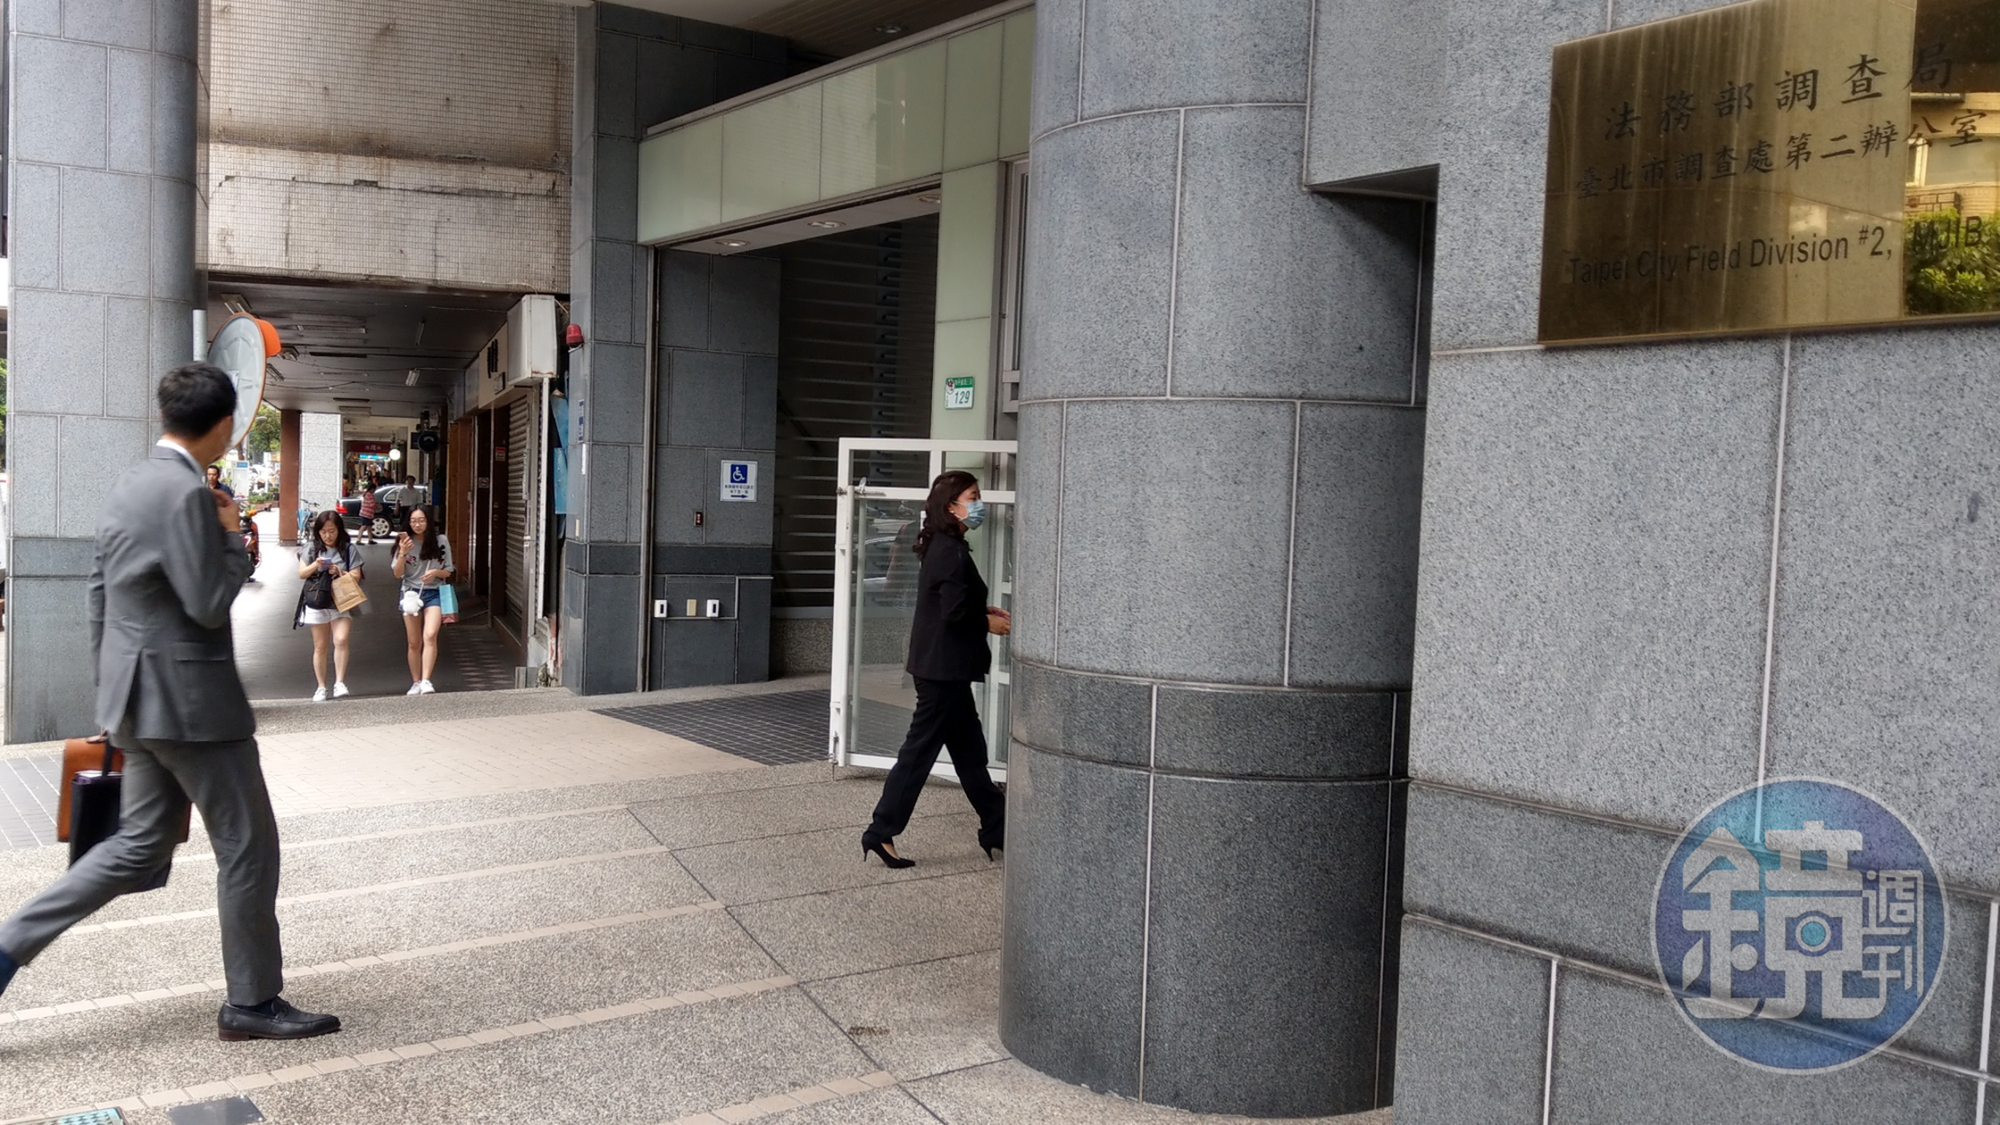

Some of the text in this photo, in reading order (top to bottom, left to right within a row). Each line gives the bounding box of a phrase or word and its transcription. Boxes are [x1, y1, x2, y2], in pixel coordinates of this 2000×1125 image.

[1603, 42, 1955, 142] 法務部調查局
[1575, 109, 1988, 200] 臺北市調查處第二辦公室
[1569, 252, 1630, 289] Taipei
[1637, 249, 1678, 283] City
[1686, 241, 1741, 274] Field
[1750, 232, 1850, 266] Division
[1912, 215, 1982, 256] MJIB
[954, 390, 971, 405] 129
